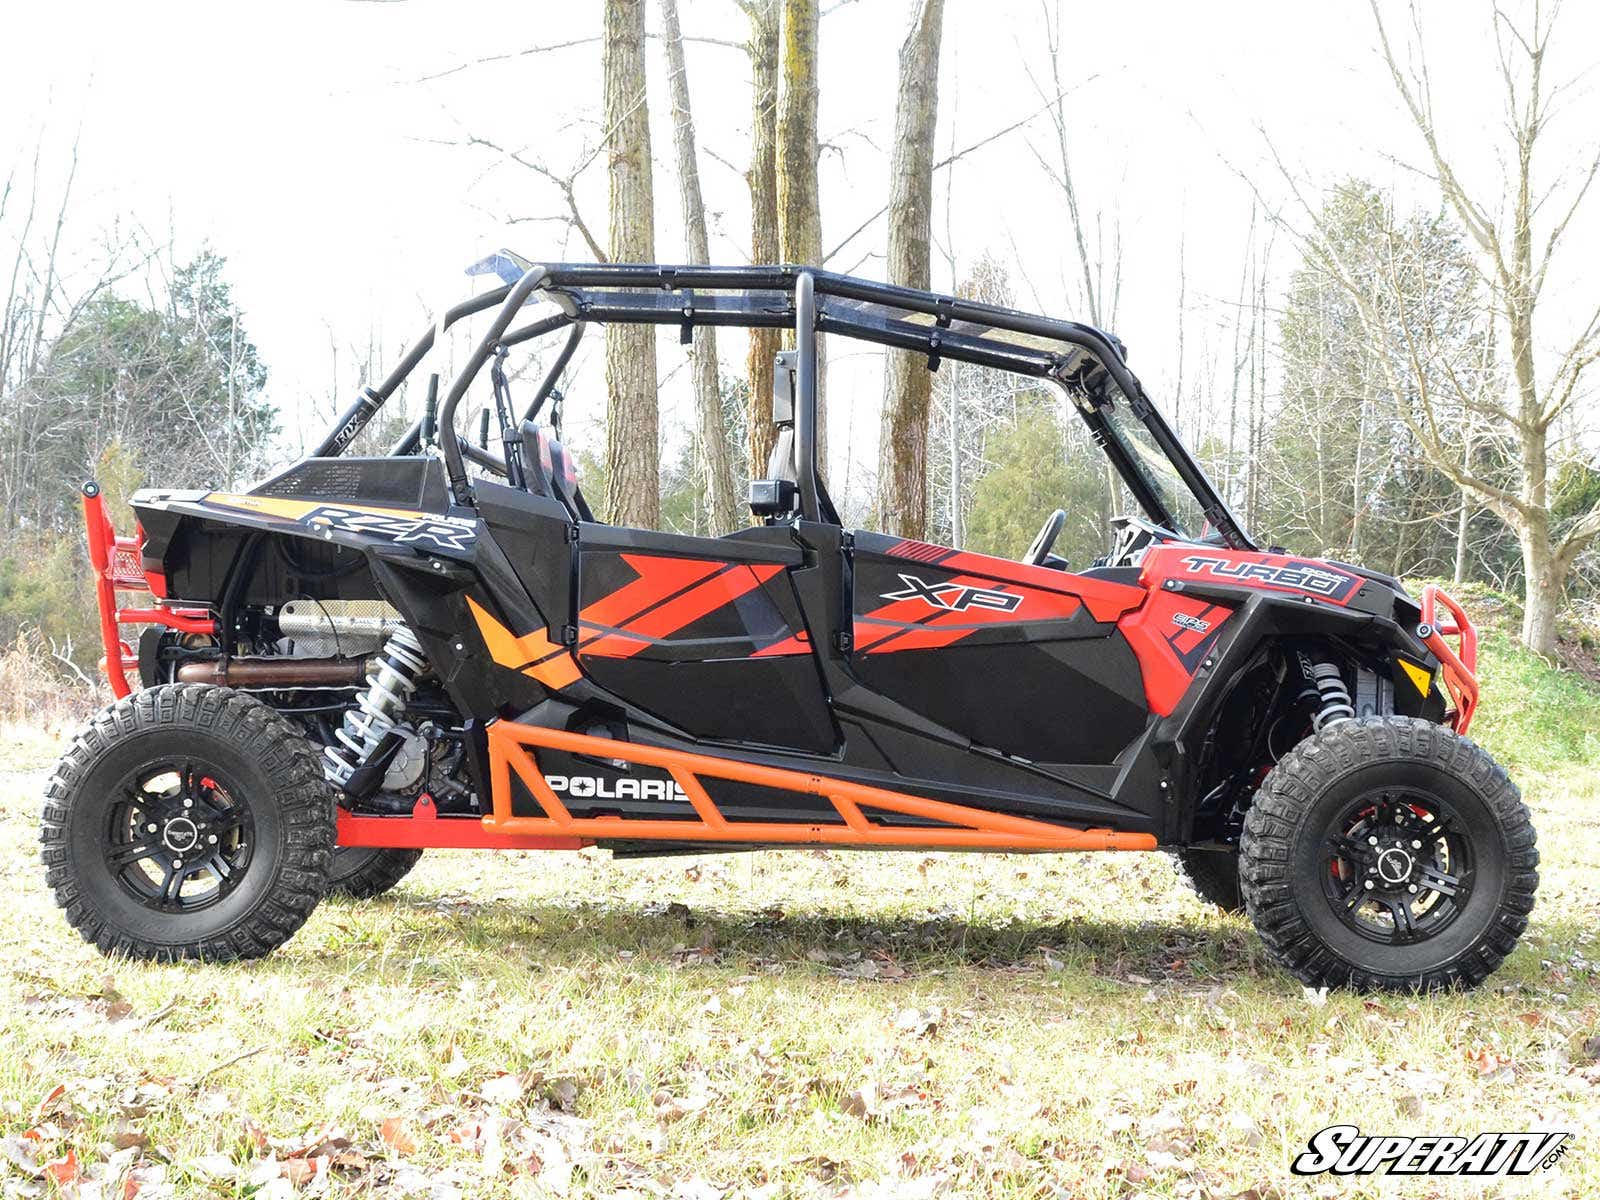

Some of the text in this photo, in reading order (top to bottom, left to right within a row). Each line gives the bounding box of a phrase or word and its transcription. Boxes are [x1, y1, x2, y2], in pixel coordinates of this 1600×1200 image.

[306, 506, 477, 551] RZR
[879, 573, 1024, 613] XP
[1180, 556, 1341, 595] TURBO
